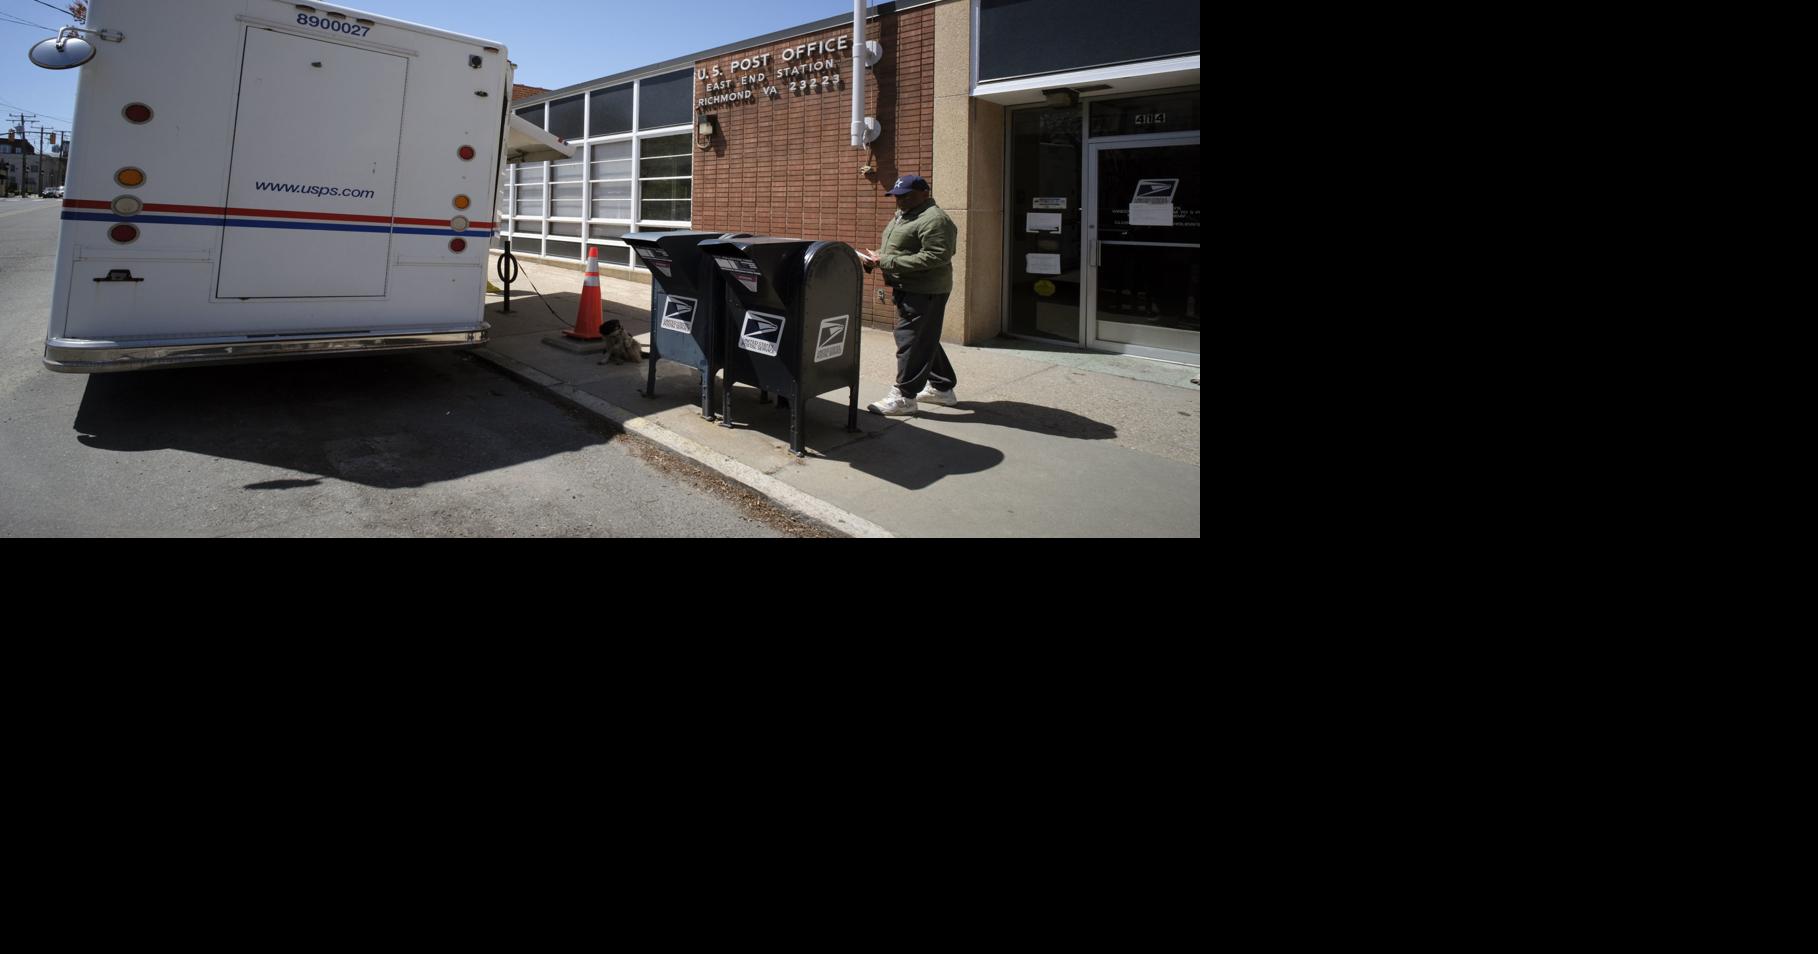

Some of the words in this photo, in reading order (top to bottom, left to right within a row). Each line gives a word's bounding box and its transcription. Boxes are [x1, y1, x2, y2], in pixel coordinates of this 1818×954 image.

[296, 13, 371, 37] 8900027
[698, 65, 723, 80] U.S.
[731, 53, 770, 73] POST
[781, 35, 848, 61] OFFICE
[698, 90, 751, 106] RICHMOND
[763, 85, 778, 96] VA
[789, 74, 840, 91] 23223
[706, 79, 732, 92] EAST
[741, 73, 765, 85] END
[777, 59, 834, 78] STATION
[255, 180, 375, 199] www.usps.com
